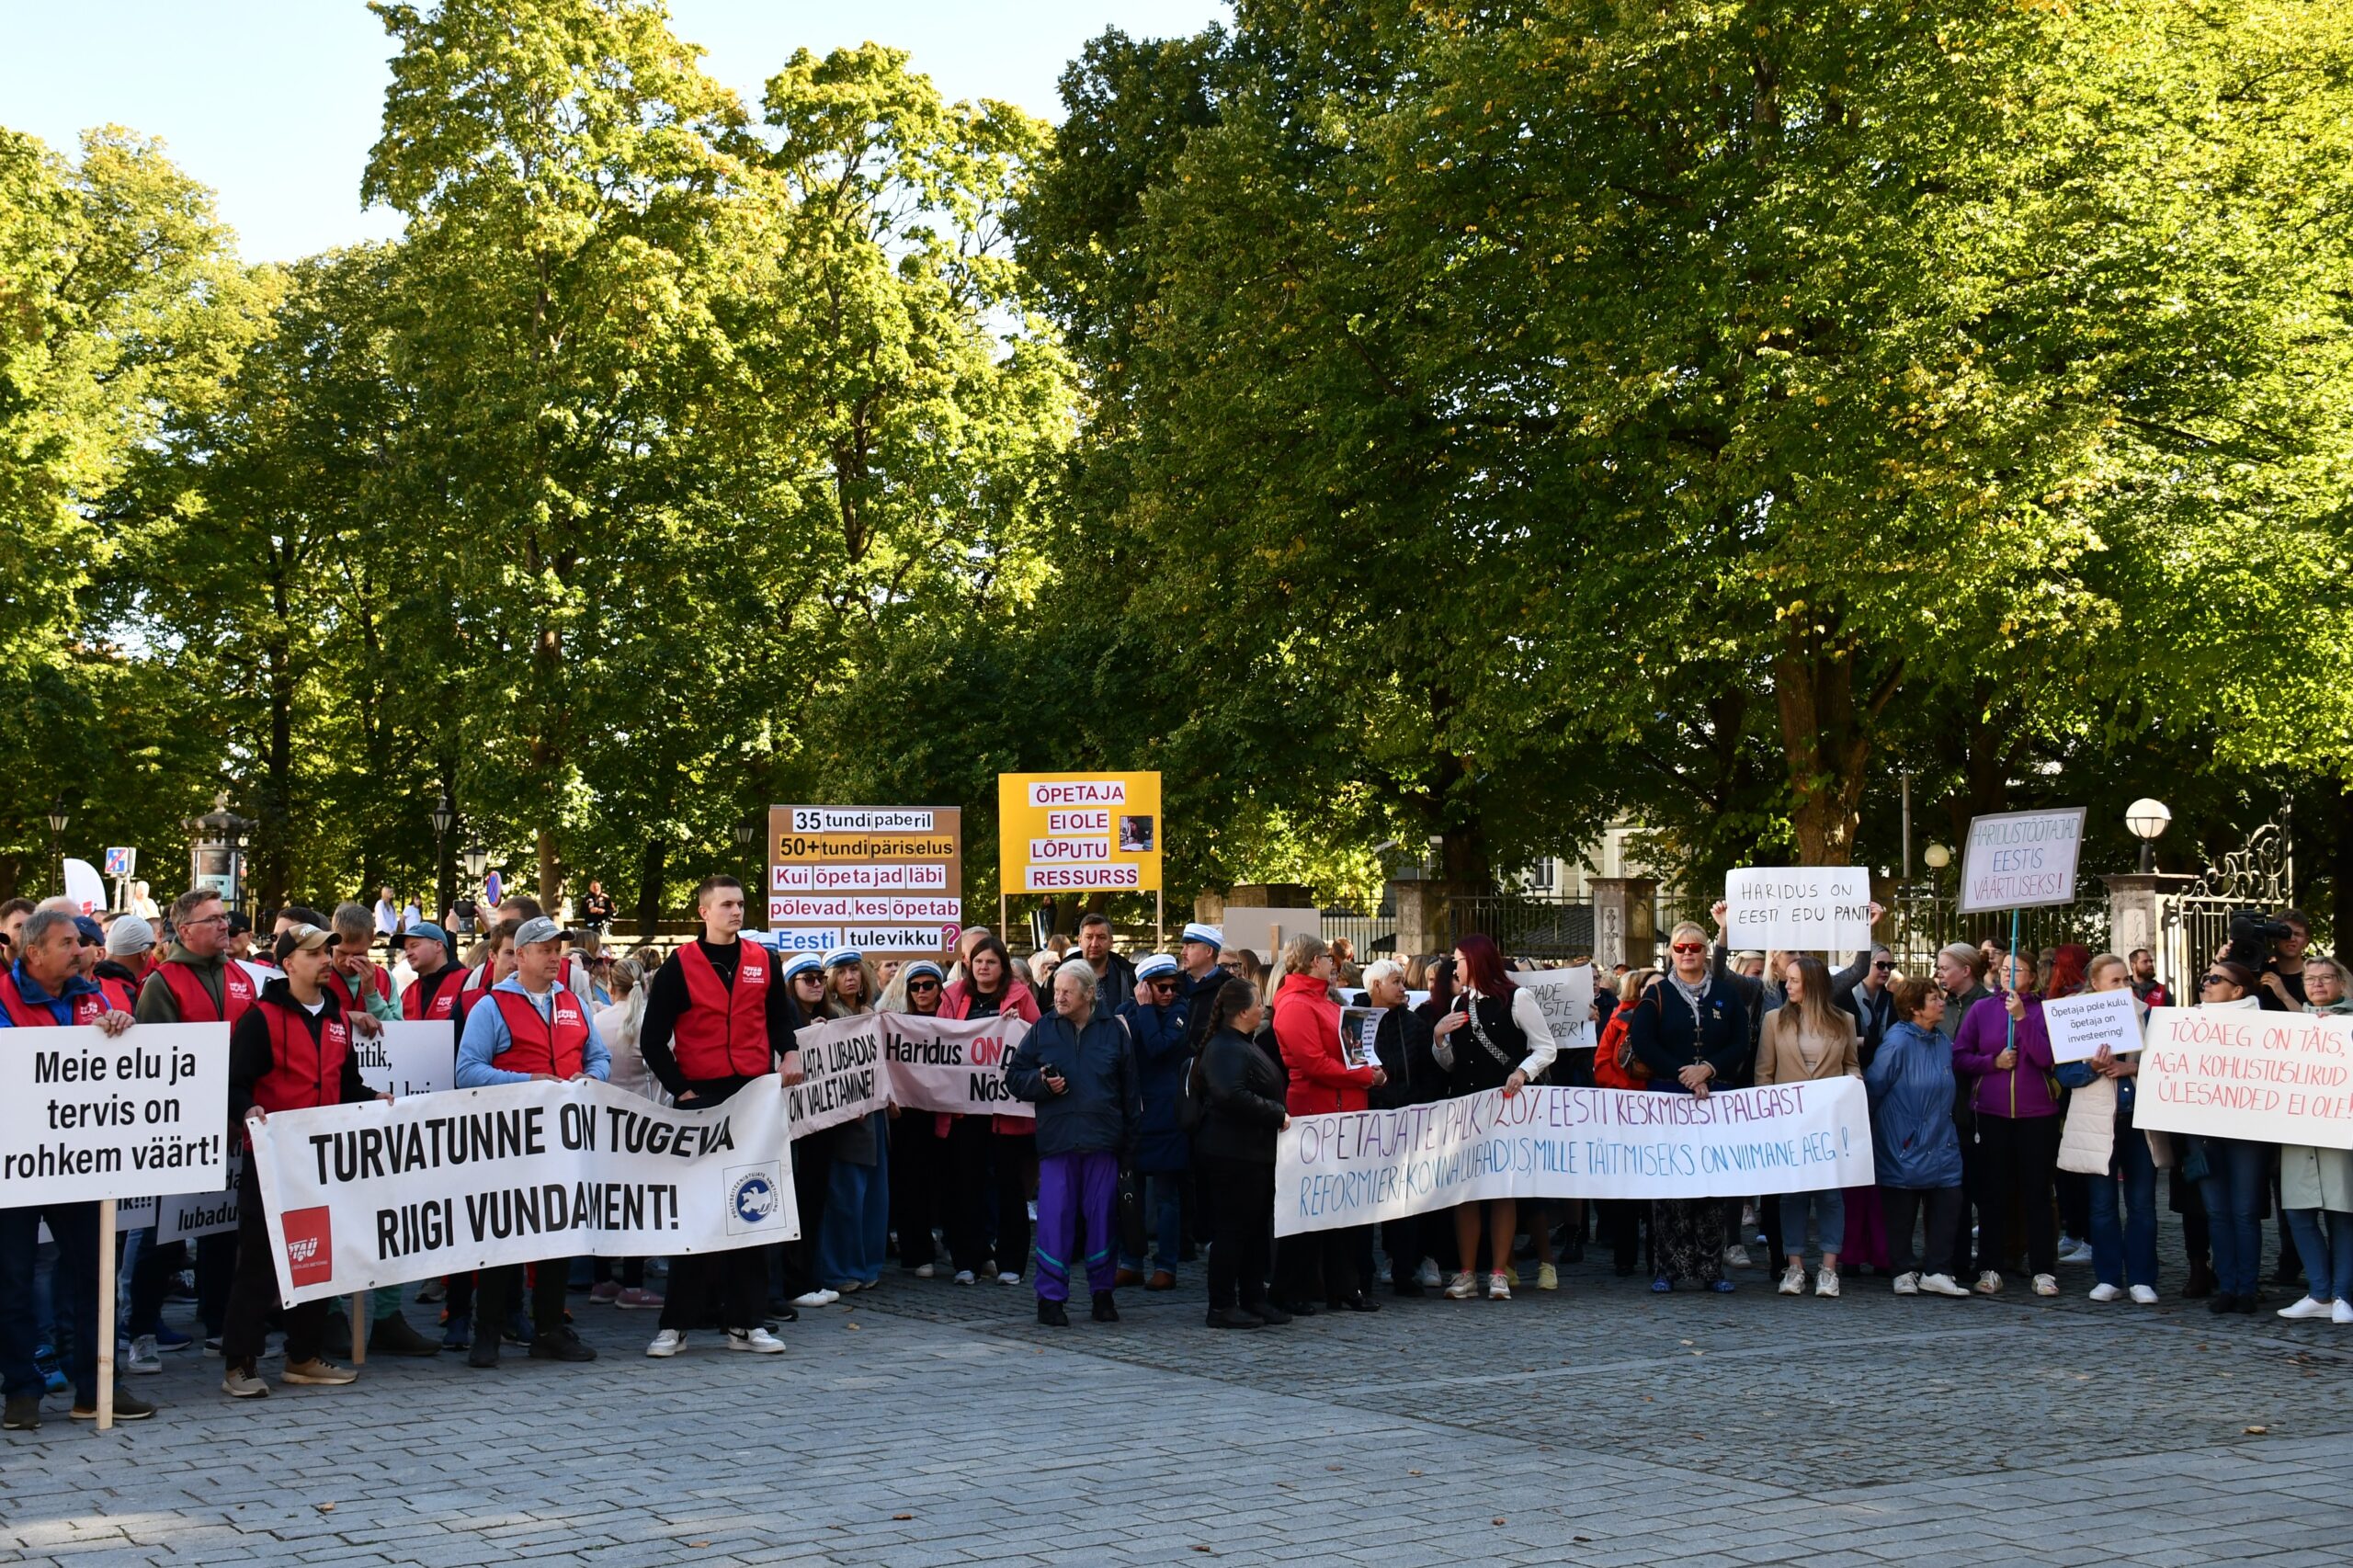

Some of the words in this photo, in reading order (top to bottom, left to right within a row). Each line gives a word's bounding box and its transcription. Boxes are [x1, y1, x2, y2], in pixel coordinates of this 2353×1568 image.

[1036, 784, 1124, 803] ÕPETAJA
[795, 812, 822, 831] 35
[825, 812, 871, 827] tundi
[874, 813, 931, 829] paberil
[1050, 814, 1066, 830] EI
[1070, 813, 1108, 829] OLE
[1972, 817, 2080, 846] HARIDUSTÖÖTAJAD
[780, 837, 820, 857] 50+
[822, 839, 868, 856] tundi
[870, 840, 953, 858] päriselus
[1032, 839, 1108, 858] LÕPUTU
[1993, 847, 2044, 872] EESTIS
[776, 869, 809, 884] Kui
[815, 868, 903, 887] õpetajad
[909, 868, 942, 883] läbi
[1033, 869, 1138, 887] RESSURSS
[1973, 872, 2063, 901] VÄÄRTUSEKS!
[1741, 882, 1819, 901] HARIDUS
[1830, 883, 1852, 897] ON
[770, 899, 853, 919] põlevad,
[855, 900, 889, 915] kes
[892, 900, 959, 919] õpetab
[1738, 906, 1780, 924] EESTI
[1791, 907, 1825, 923] EDU
[1834, 905, 1870, 926] PANT!
[779, 930, 835, 949] Eesti
[1526, 983, 1564, 1002] JADE
[2051, 1006, 2085, 1018] Õpetaja
[2086, 1003, 2105, 1014] pole
[2107, 998, 2129, 1008] kulu,
[2070, 1017, 2103, 1029] õpetaja
[2104, 1015, 2116, 1023] on
[2067, 1027, 2123, 1043] investeering!
[2169, 1017, 2251, 1048] TÖÖAEG
[2263, 1028, 2291, 1051] ON
[2298, 1026, 2346, 1058] TÄIS,
[828, 1032, 878, 1074] LUBADUS
[885, 1032, 962, 1066] Haridus
[971, 1036, 1004, 1066] ON
[35, 1049, 108, 1084] Meie
[116, 1047, 162, 1080] elu
[168, 1045, 196, 1086] ja
[2150, 1051, 2189, 1074] AGA
[2198, 1054, 2347, 1087] KOHUSTUSLIKUD
[789, 1088, 804, 1123] ON
[806, 1067, 875, 1117] VALETAMINE!
[2158, 1075, 2280, 1111] ÜLESANDED
[2288, 1093, 2306, 1116] EI
[47, 1094, 135, 1130] tervis
[144, 1098, 180, 1124] on
[1300, 1105, 1438, 1165] ÕPETAJATE
[1443, 1093, 1483, 1145] PALK
[1550, 1087, 1608, 1127] EESTI
[1615, 1092, 1717, 1126] KESKMISEST
[1721, 1085, 1805, 1126] PALGAST
[5, 1142, 121, 1179] rohkem
[131, 1134, 220, 1170] väärt!
[309, 1106, 546, 1186] TURVATUNNE
[559, 1103, 597, 1152] ON
[606, 1106, 735, 1158] TUGEVA
[1533, 1138, 1578, 1175] MILLE
[1586, 1136, 1696, 1176] TÄITMISEKS
[1700, 1144, 1729, 1175] ON
[1728, 1140, 1800, 1172] VIIMANE
[376, 1198, 455, 1261] RIIGI
[464, 1181, 679, 1243] VUNDAMENT!
